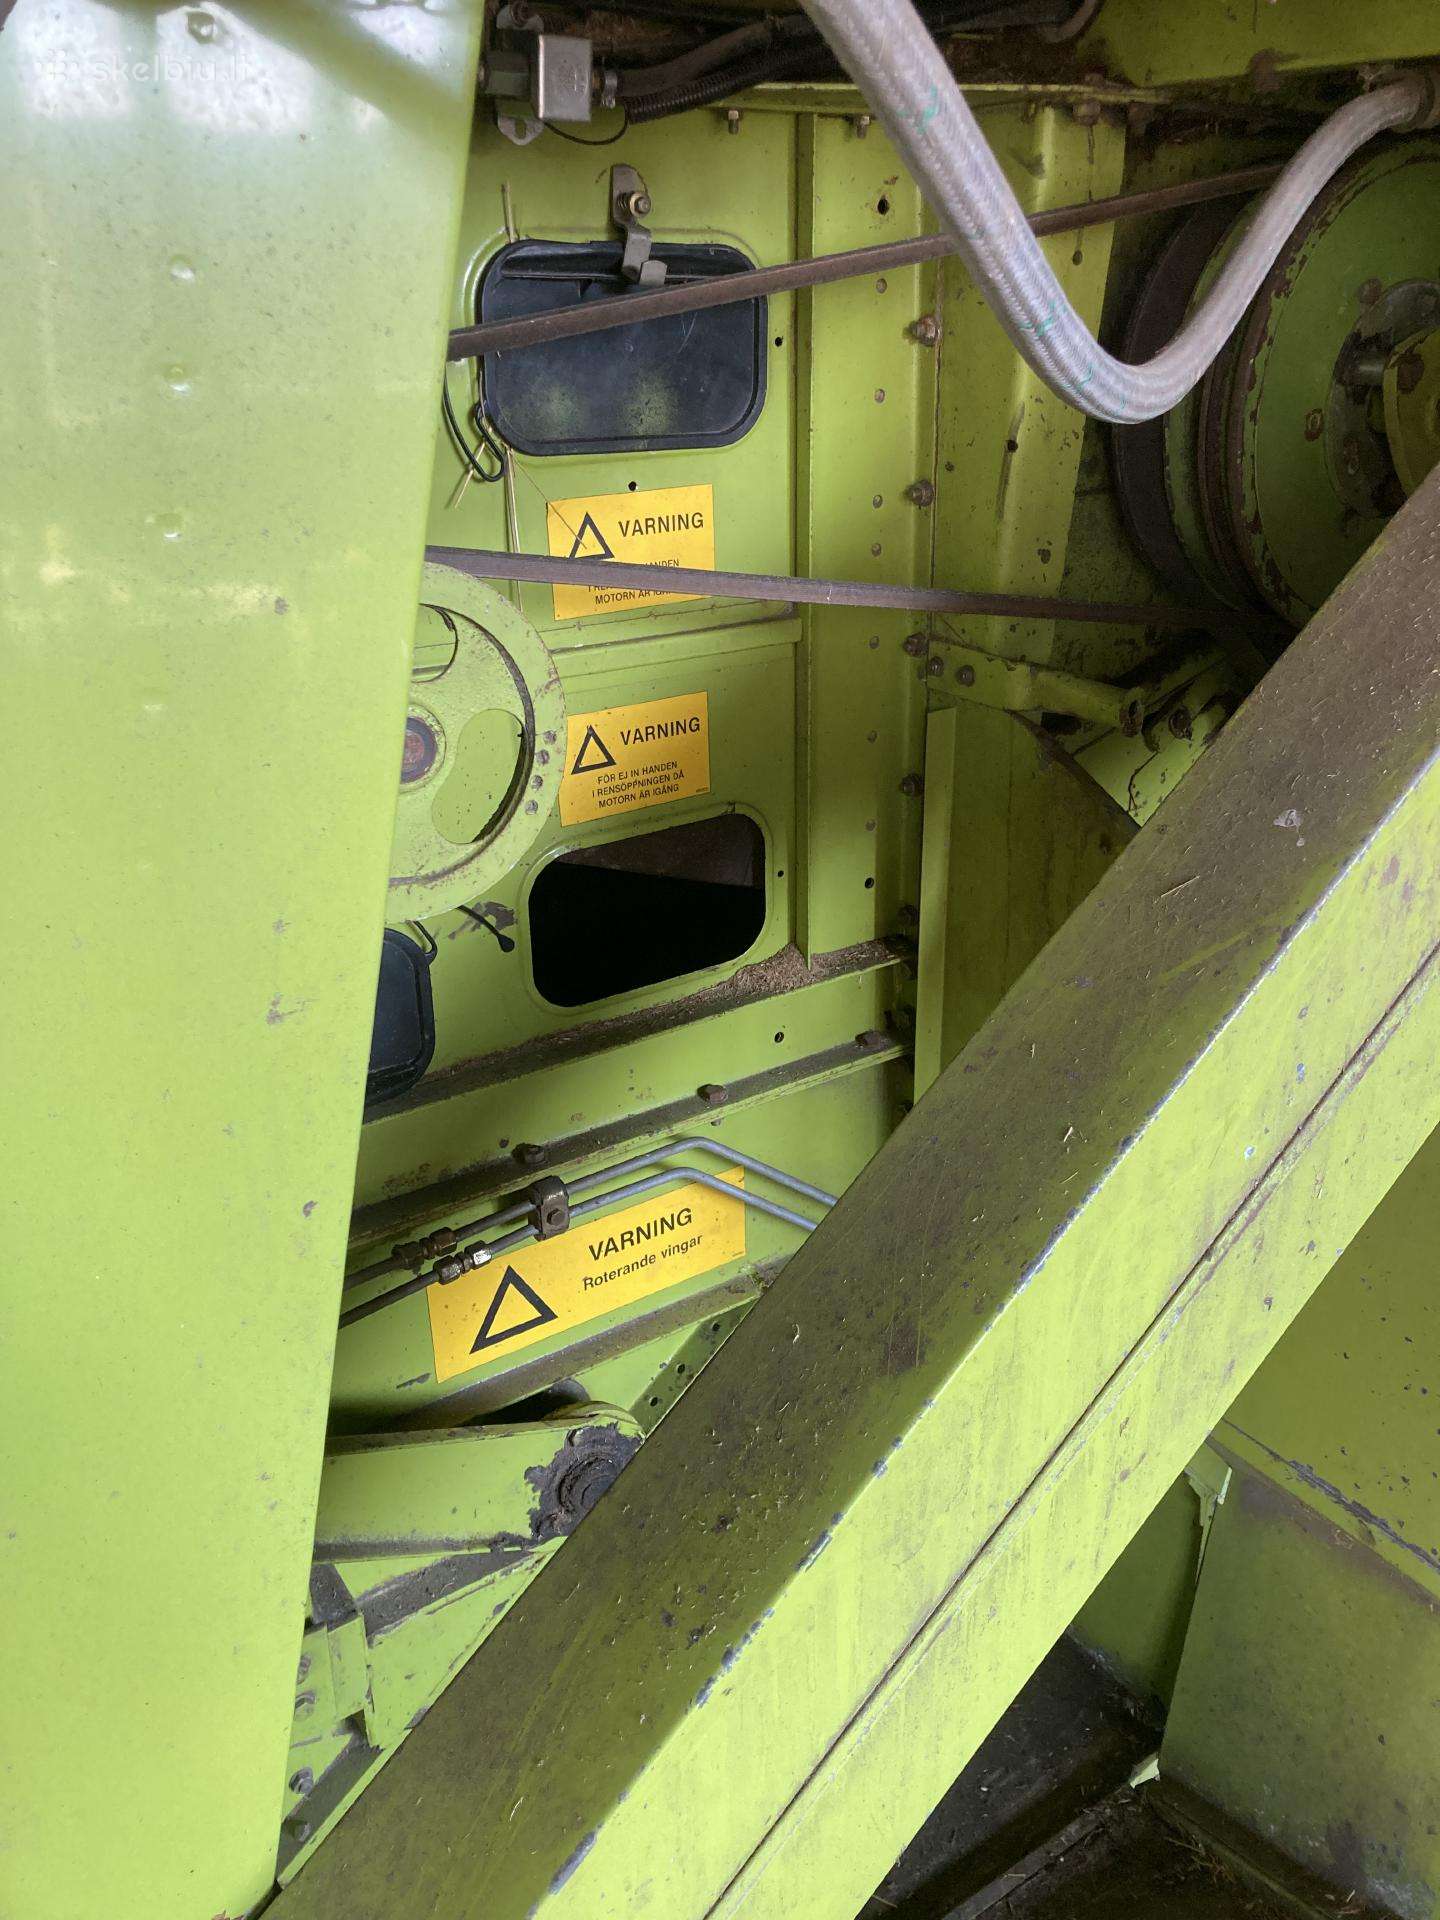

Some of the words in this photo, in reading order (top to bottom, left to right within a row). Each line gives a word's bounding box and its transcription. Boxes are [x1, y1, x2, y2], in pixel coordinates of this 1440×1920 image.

[618, 512, 704, 537] VARNING
[595, 591, 636, 605] MOTORN
[620, 717, 701, 746] VARNING
[597, 772, 616, 785] FÖR
[618, 771, 628, 781] EJ
[630, 769, 640, 778] IN
[642, 761, 678, 776] HANDEN
[597, 774, 671, 797] RENSÖPPNINGEN
[673, 769, 685, 780] DÅ
[598, 793, 636, 809] MOTORN
[588, 1207, 693, 1261] VARNING
[582, 1254, 657, 1291] Roterande
[661, 1234, 703, 1265] vingar
